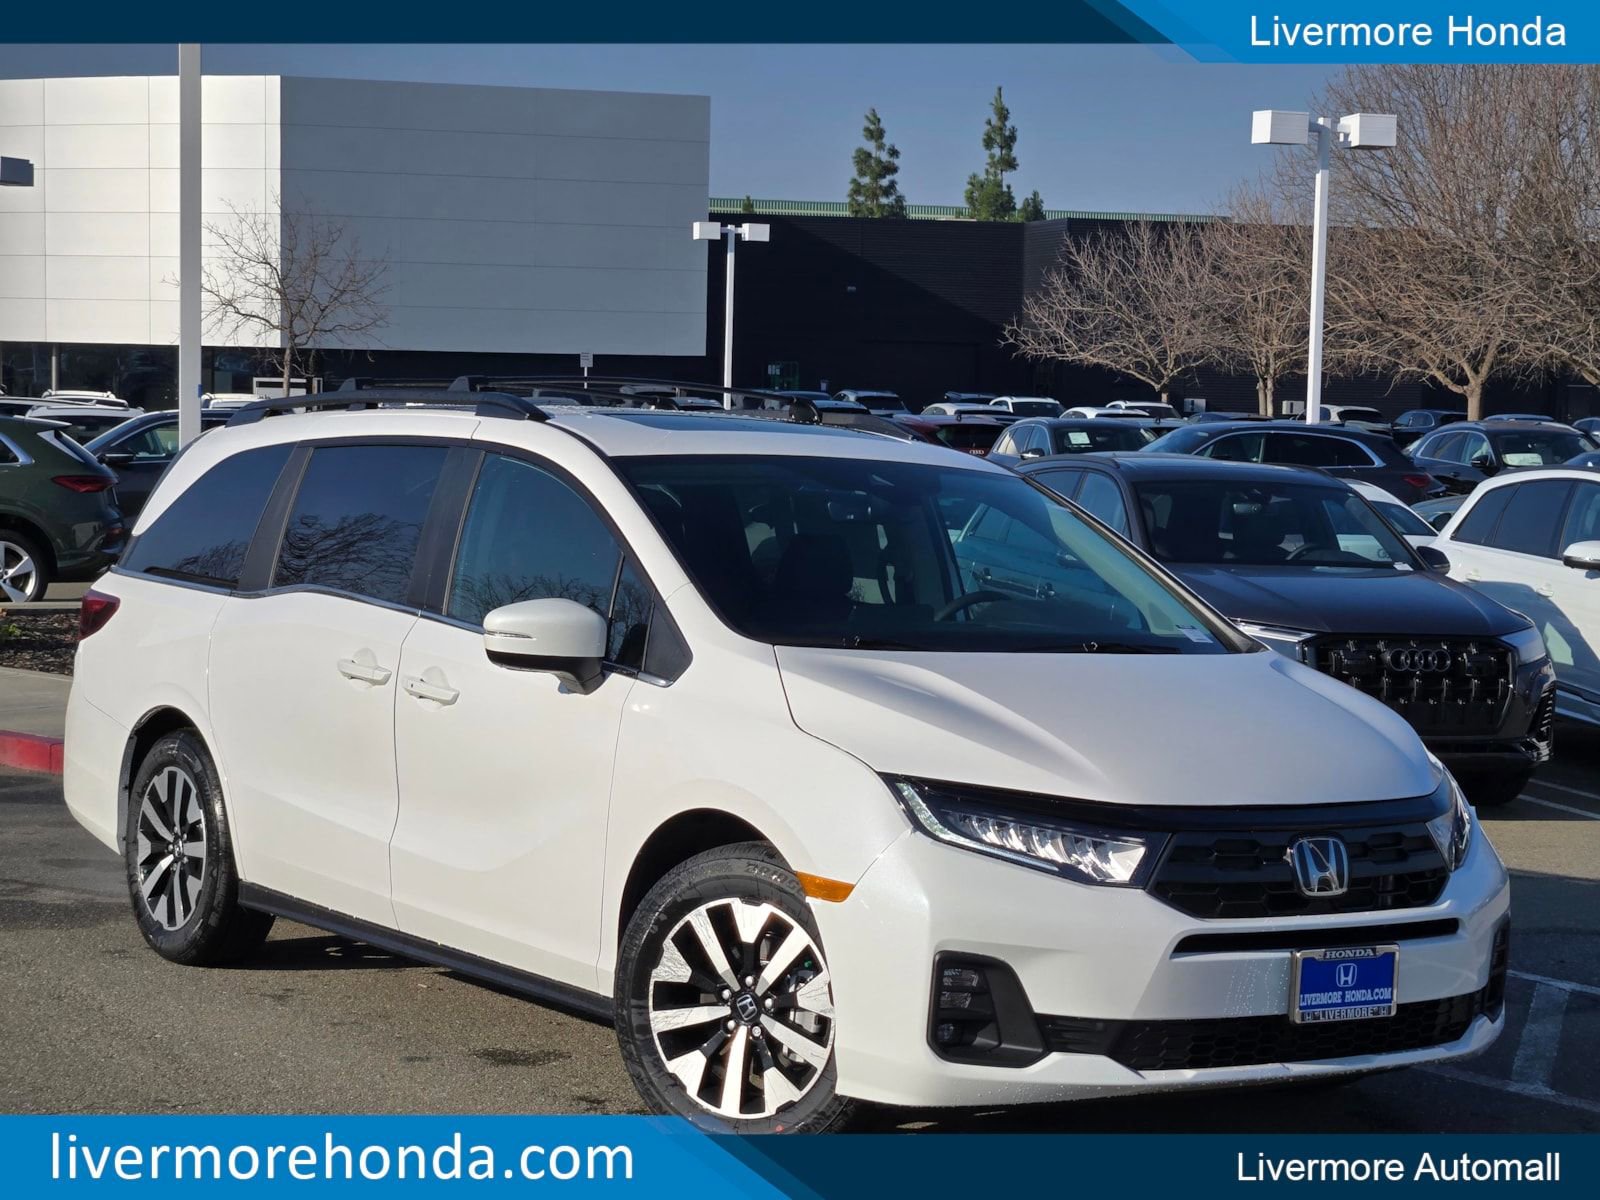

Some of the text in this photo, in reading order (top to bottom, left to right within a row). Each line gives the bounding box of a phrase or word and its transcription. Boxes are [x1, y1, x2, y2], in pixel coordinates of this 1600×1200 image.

[1325, 948, 1374, 959] HONDA
[1300, 987, 1392, 1006] LIVERMORE HONDA.COM
